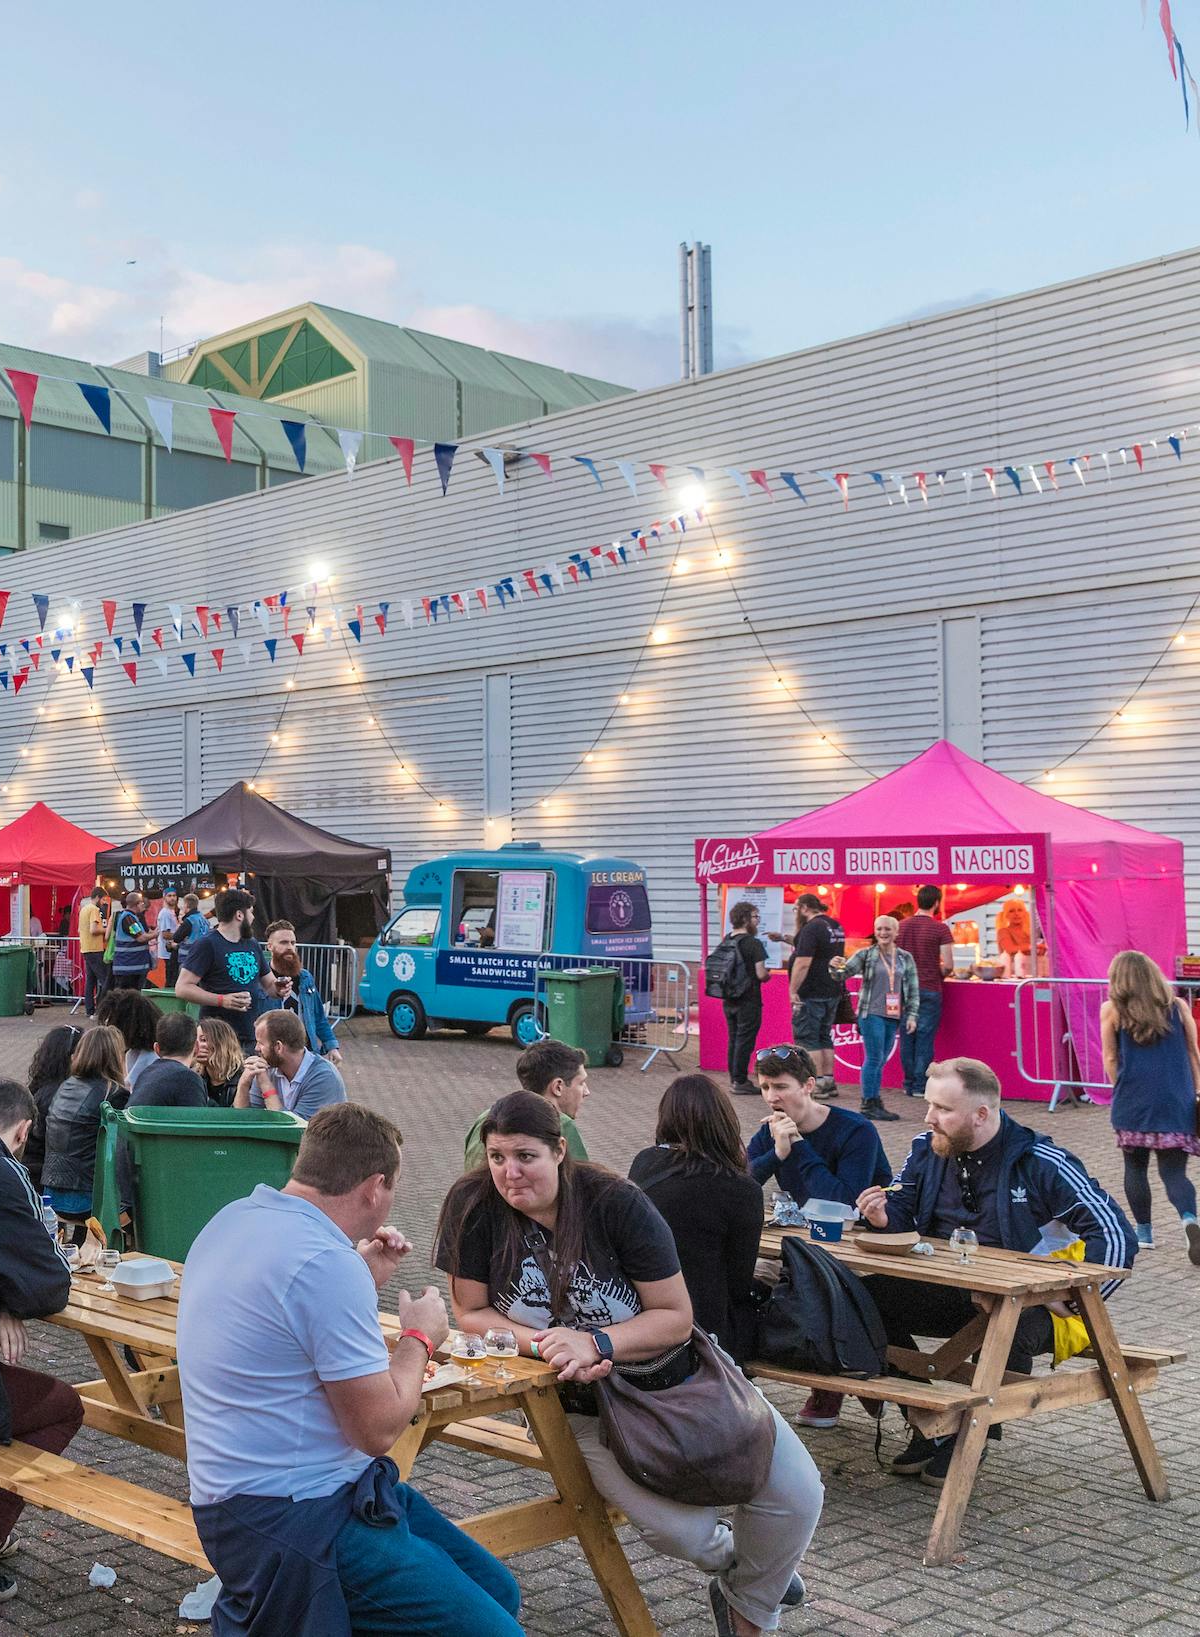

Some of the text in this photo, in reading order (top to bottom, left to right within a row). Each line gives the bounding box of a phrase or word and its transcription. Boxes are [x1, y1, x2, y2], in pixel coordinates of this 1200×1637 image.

[140, 837, 197, 858] KOLKATI
[711, 842, 755, 866] Club
[697, 856, 765, 877] Mexicana
[776, 848, 1031, 872] TACOS BURRITOS NACHOS
[120, 866, 137, 877] HOT
[138, 865, 156, 876] KATI
[591, 871, 643, 883] ICE CREAM
[449, 956, 552, 969] SMALL BATCH ICE CREAM
[471, 967, 527, 978] SANDWICHES
